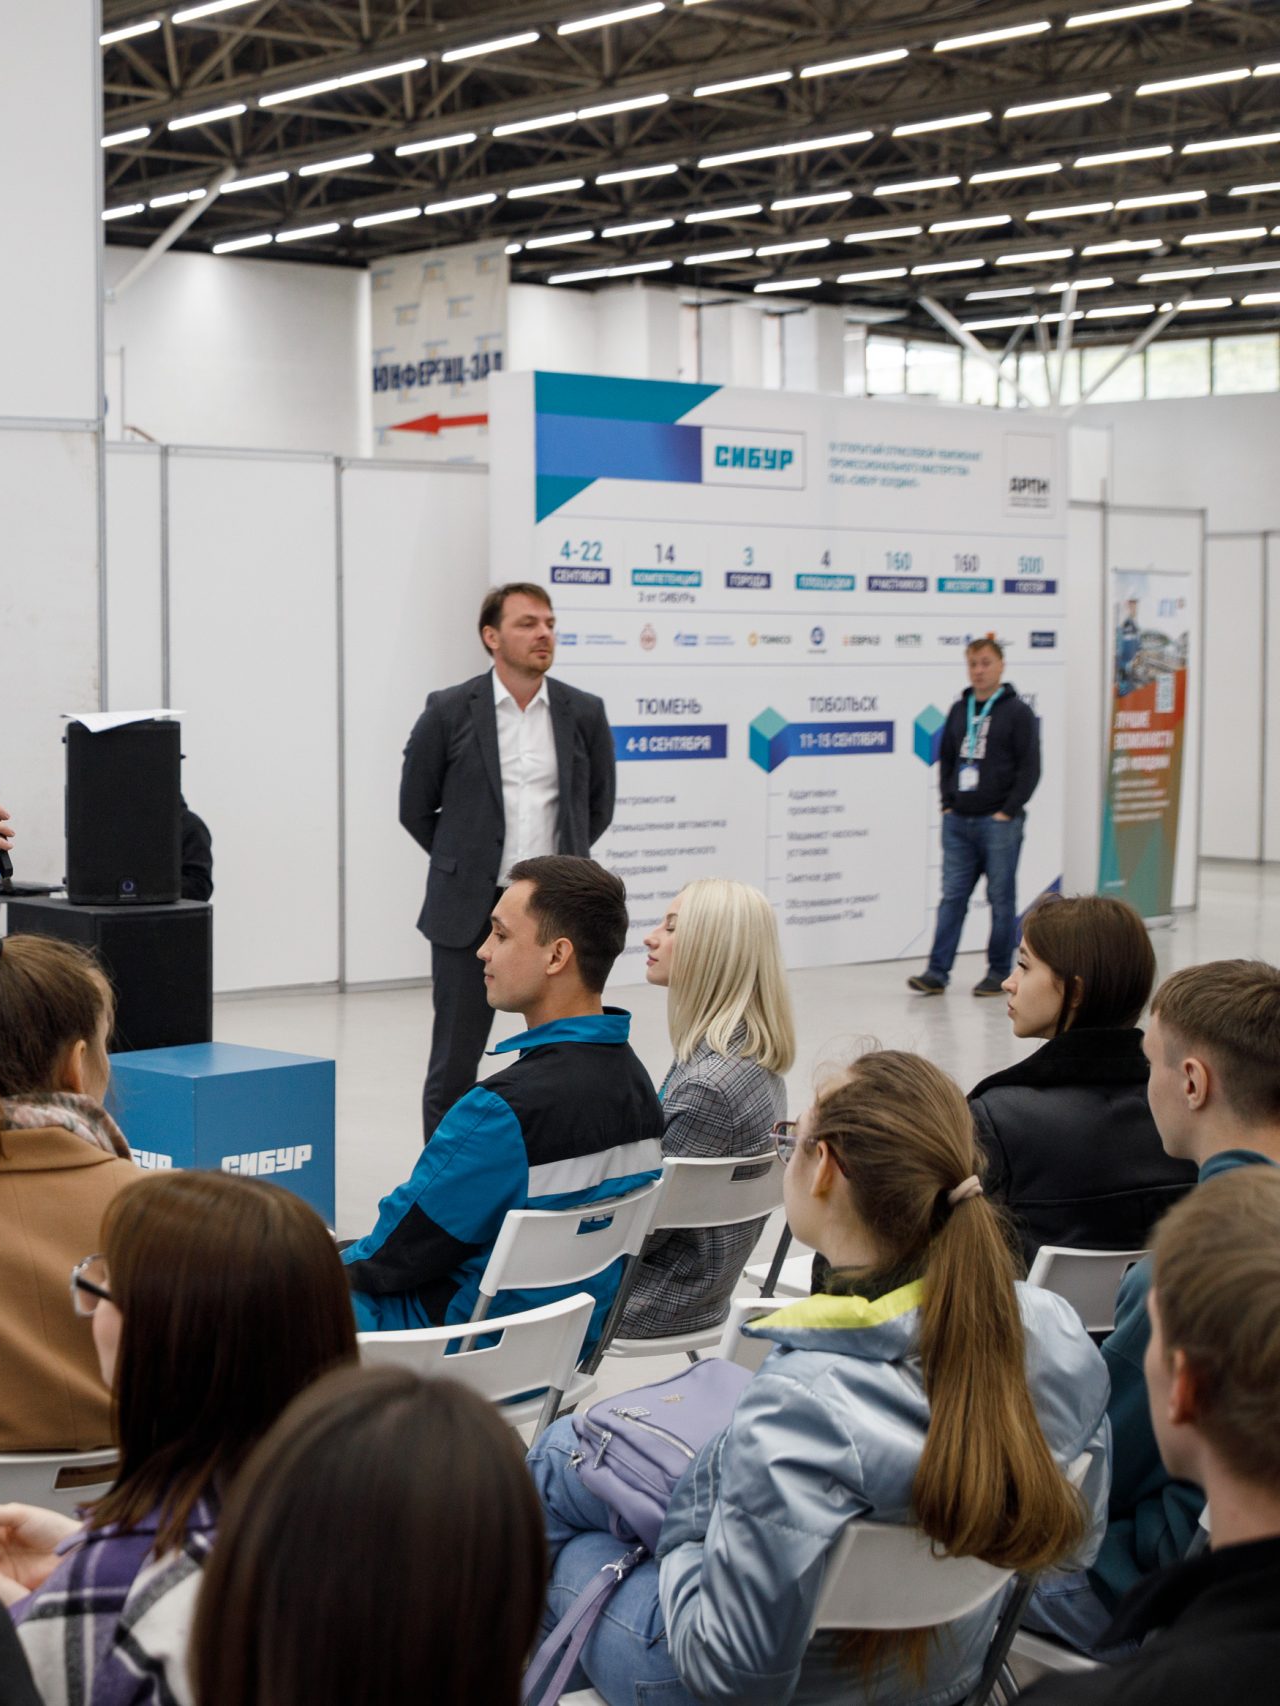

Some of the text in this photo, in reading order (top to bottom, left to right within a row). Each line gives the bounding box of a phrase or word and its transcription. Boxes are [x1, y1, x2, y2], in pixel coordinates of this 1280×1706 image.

[714, 445, 793, 470] СИБУР
[560, 540, 602, 562] 4-22
[654, 544, 675, 564] 14
[743, 546, 754, 566] 3
[820, 550, 831, 568] 4
[554, 568, 608, 583] СЕНТЯБРЯ
[636, 698, 703, 715] ТЮМЕНЬ
[809, 695, 878, 713] ТОБОЛЬСК
[649, 735, 711, 752] СЕНТЯБРЯ
[130, 1147, 172, 1169] БУР
[221, 1144, 312, 1177] СИБУР
